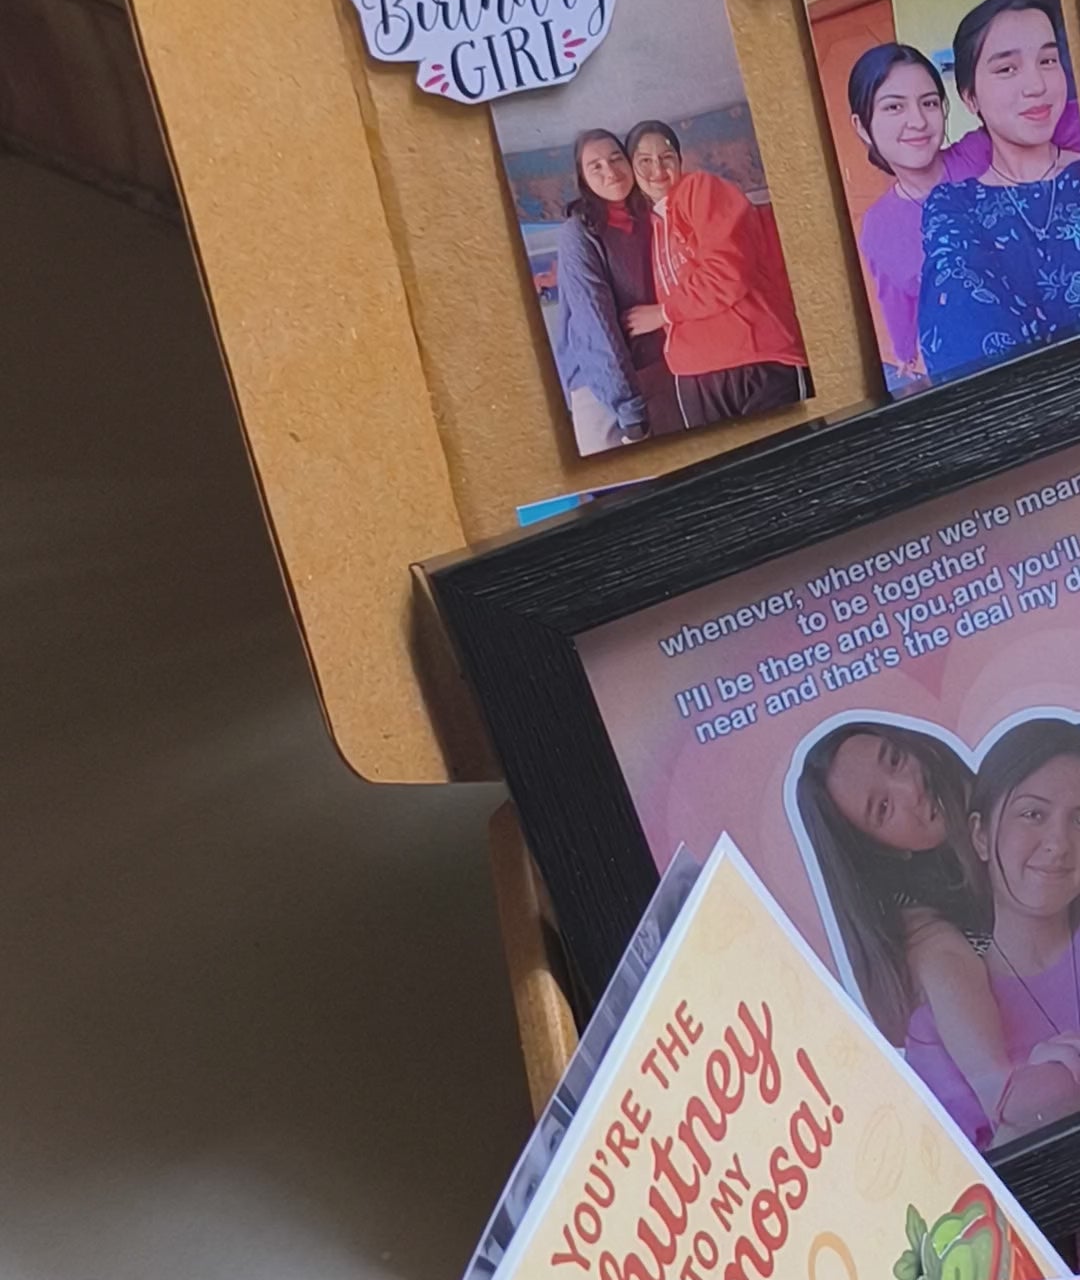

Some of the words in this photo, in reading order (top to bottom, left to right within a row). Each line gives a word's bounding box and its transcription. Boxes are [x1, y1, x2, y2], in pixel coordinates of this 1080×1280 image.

[450, 20, 577, 99] GIRL
[660, 588, 803, 656] whenever,
[807, 534, 932, 599] wherever
[938, 509, 1010, 546] we're
[675, 683, 712, 717] I'll
[716, 673, 754, 701] be
[758, 641, 831, 683] there
[837, 612, 890, 653] and
[1009, 535, 1080, 589] you'll
[797, 612, 826, 635] to
[831, 595, 869, 622] be
[872, 544, 986, 605] together
[696, 702, 758, 743] near
[765, 674, 819, 715] and
[822, 647, 900, 691] that's
[904, 626, 950, 658] the
[955, 596, 1013, 637] deal
[1019, 580, 1057, 611] my
[551, 1090, 652, 1271] YOU'RE
[641, 1001, 704, 1088] THE
[711, 1154, 752, 1232] MY
